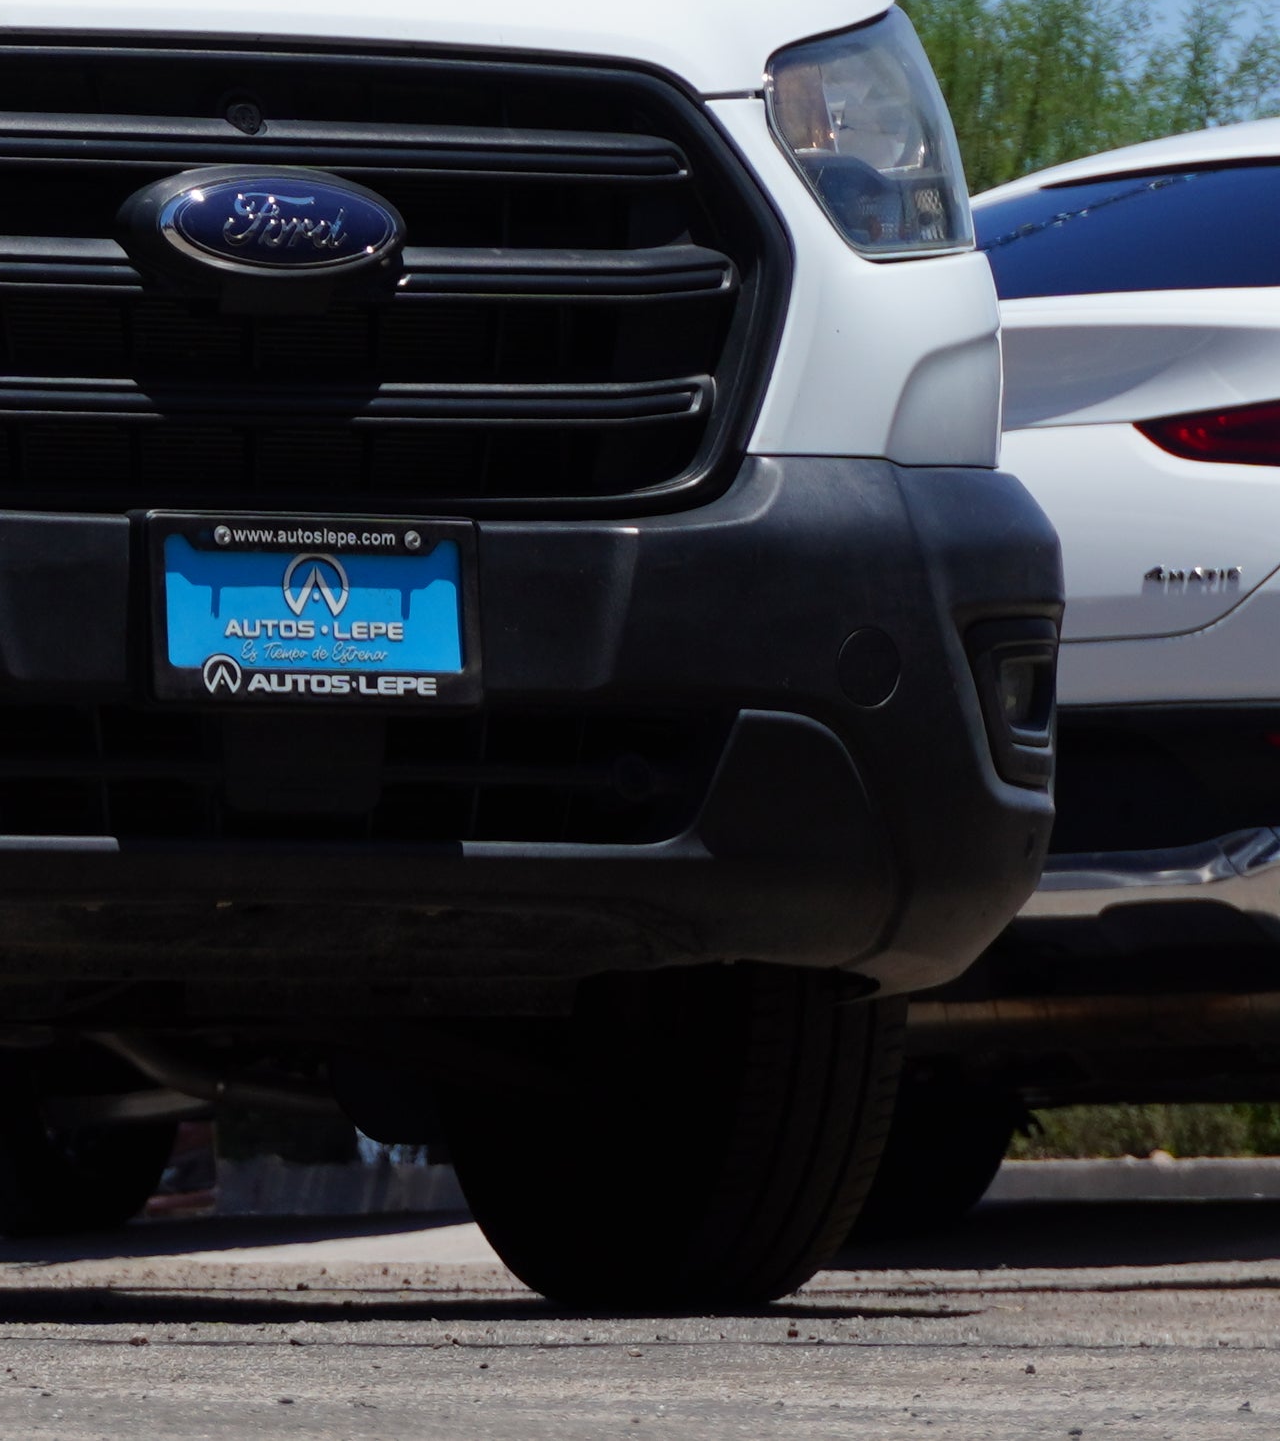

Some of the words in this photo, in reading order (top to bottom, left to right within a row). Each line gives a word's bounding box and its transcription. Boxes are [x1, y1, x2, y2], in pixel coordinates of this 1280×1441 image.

[222, 191, 349, 248] Ford
[232, 527, 396, 548] www.autoslepe.com
[224, 618, 315, 639] AUTOS
[333, 621, 404, 641] LEPE
[241, 639, 257, 662] Es
[264, 641, 308, 663] Tiempo
[311, 645, 328, 660] de
